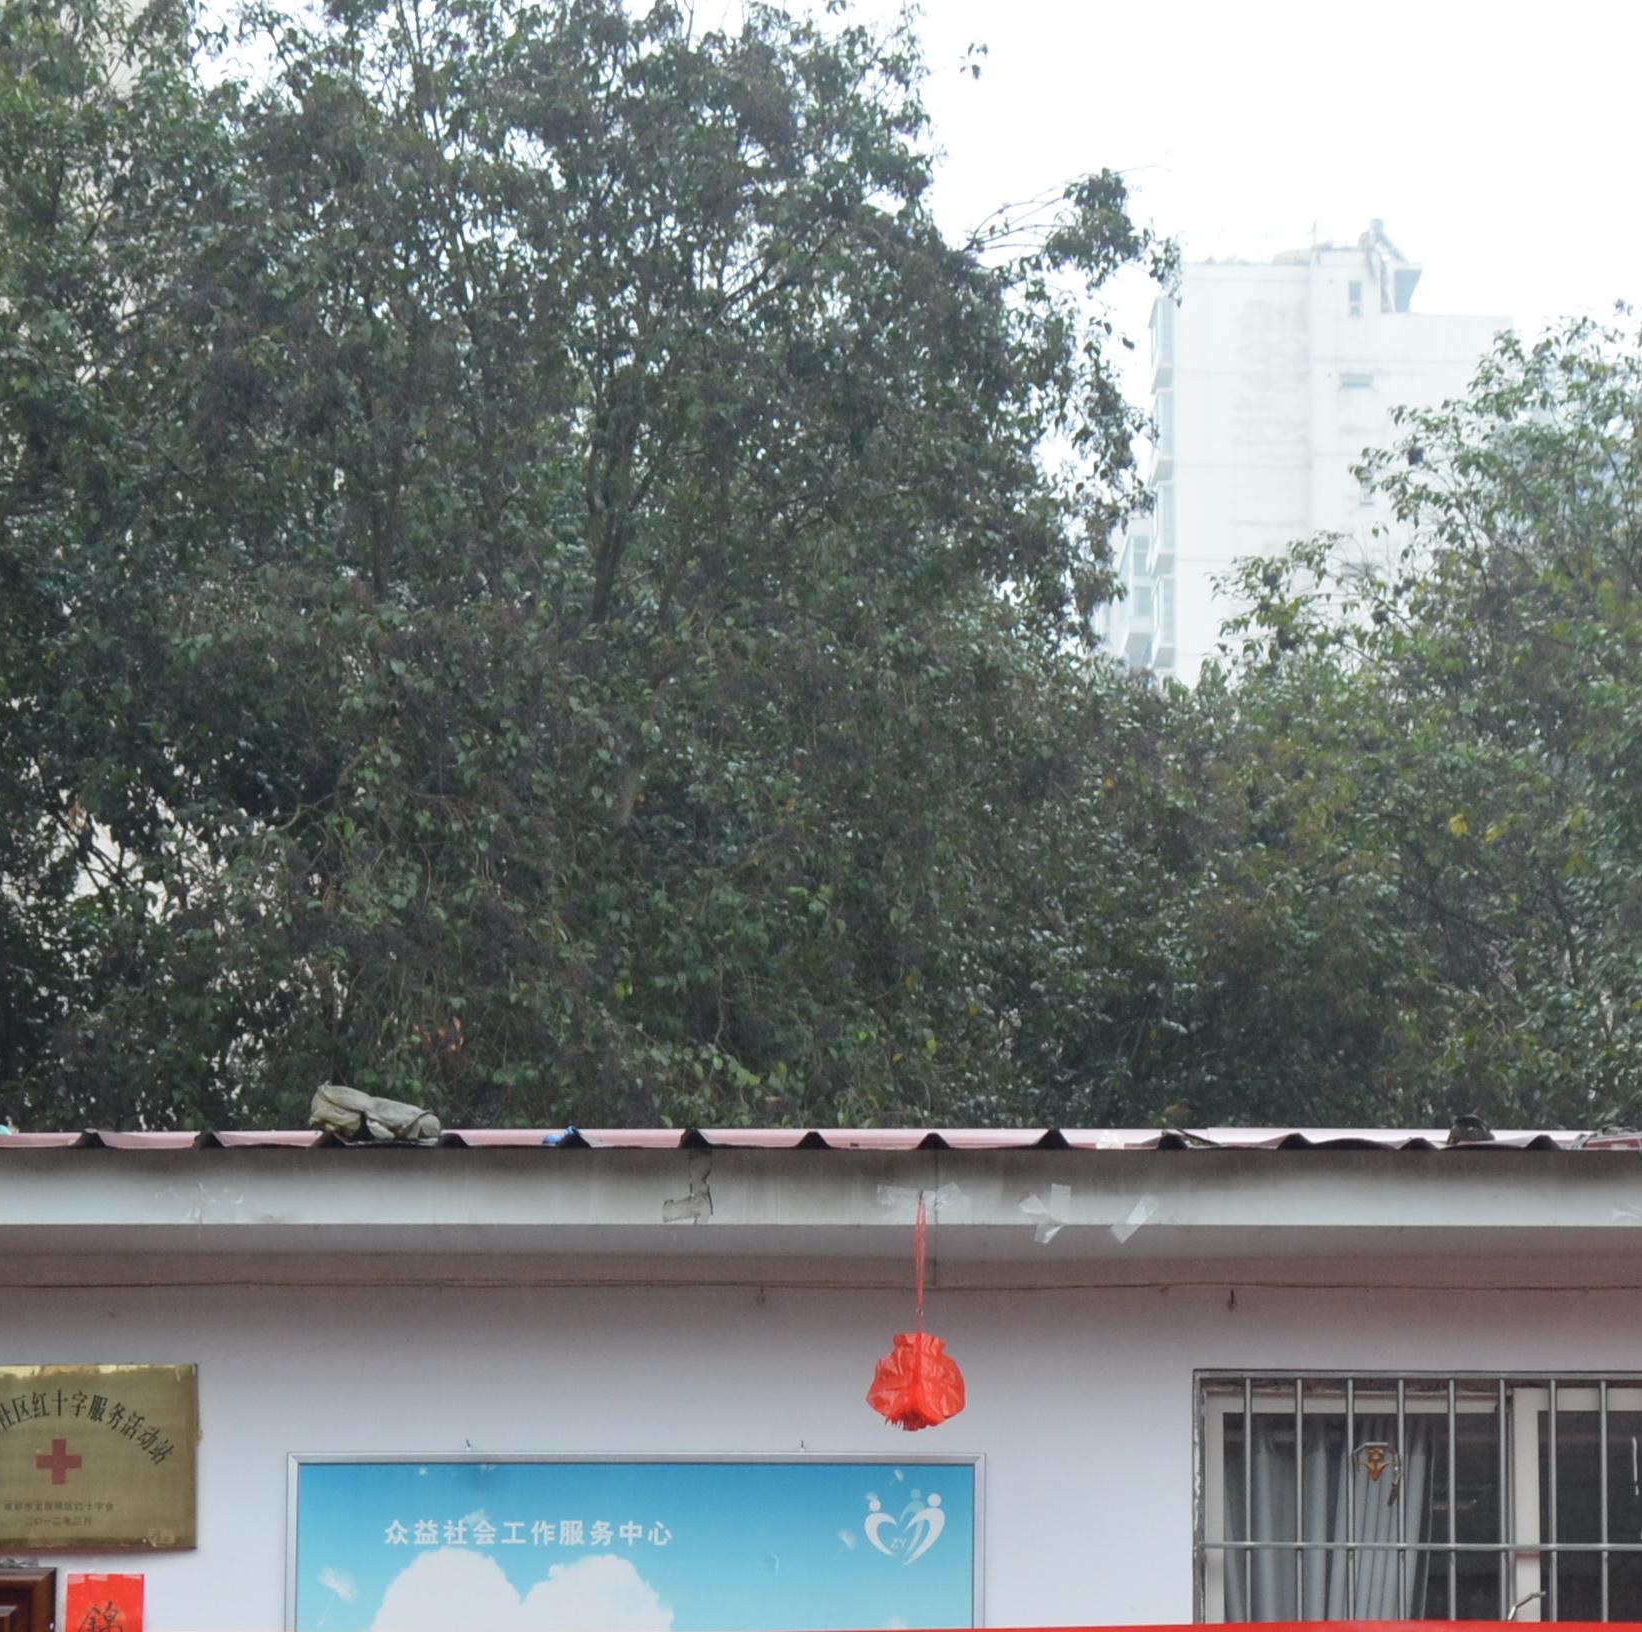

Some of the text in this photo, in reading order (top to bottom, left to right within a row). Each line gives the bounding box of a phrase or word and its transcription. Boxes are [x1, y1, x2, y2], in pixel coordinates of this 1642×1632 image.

[383, 1519, 675, 1547] 众益社会工作服务中心
